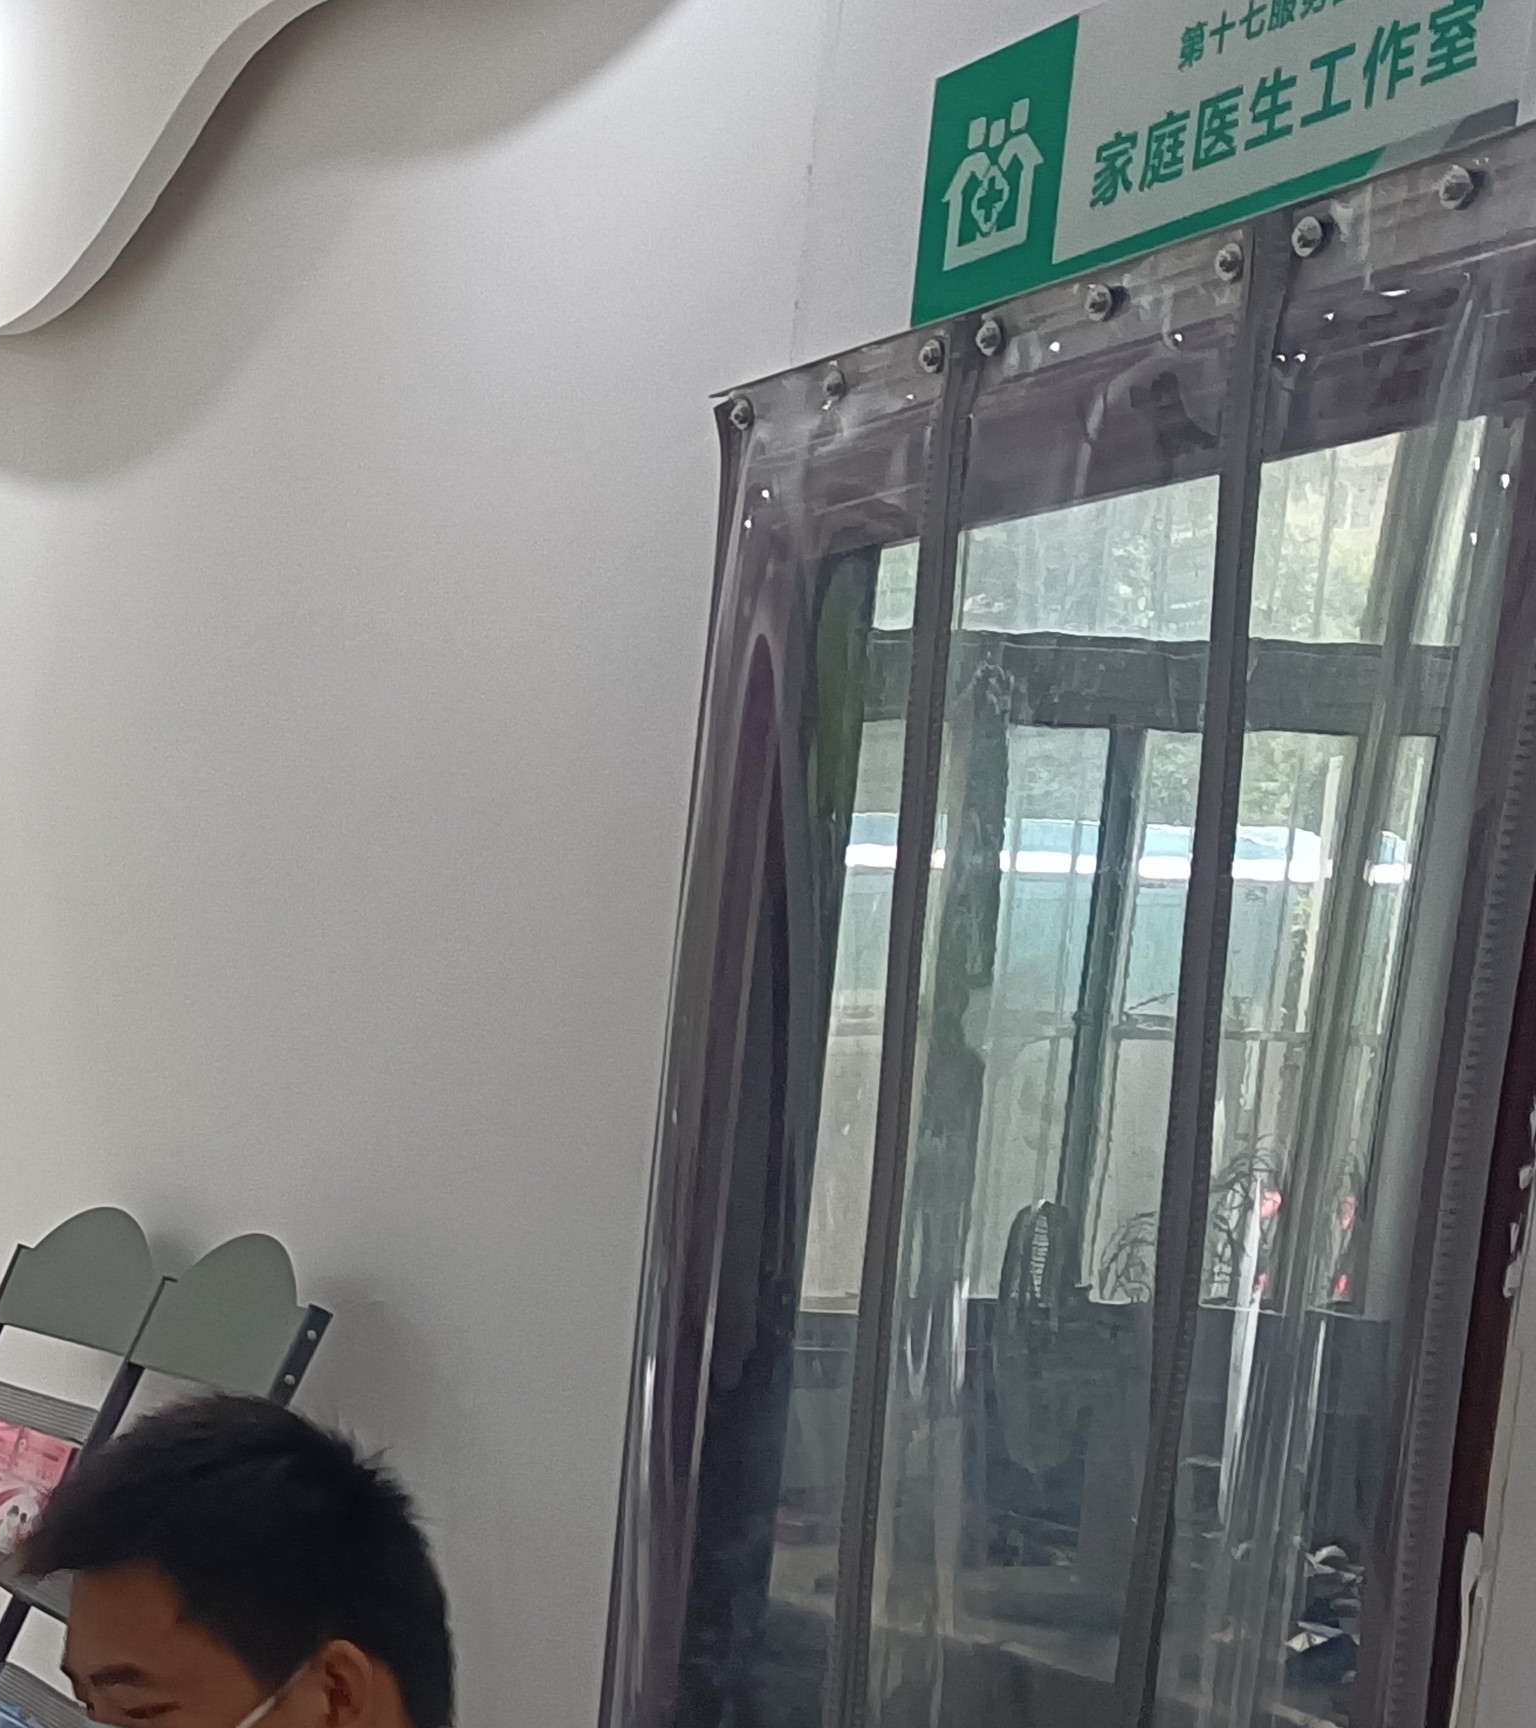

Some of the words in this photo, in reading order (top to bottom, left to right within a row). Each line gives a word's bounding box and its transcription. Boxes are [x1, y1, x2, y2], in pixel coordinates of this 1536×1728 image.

[1090, 0, 1485, 209] 家庭医生工作室
